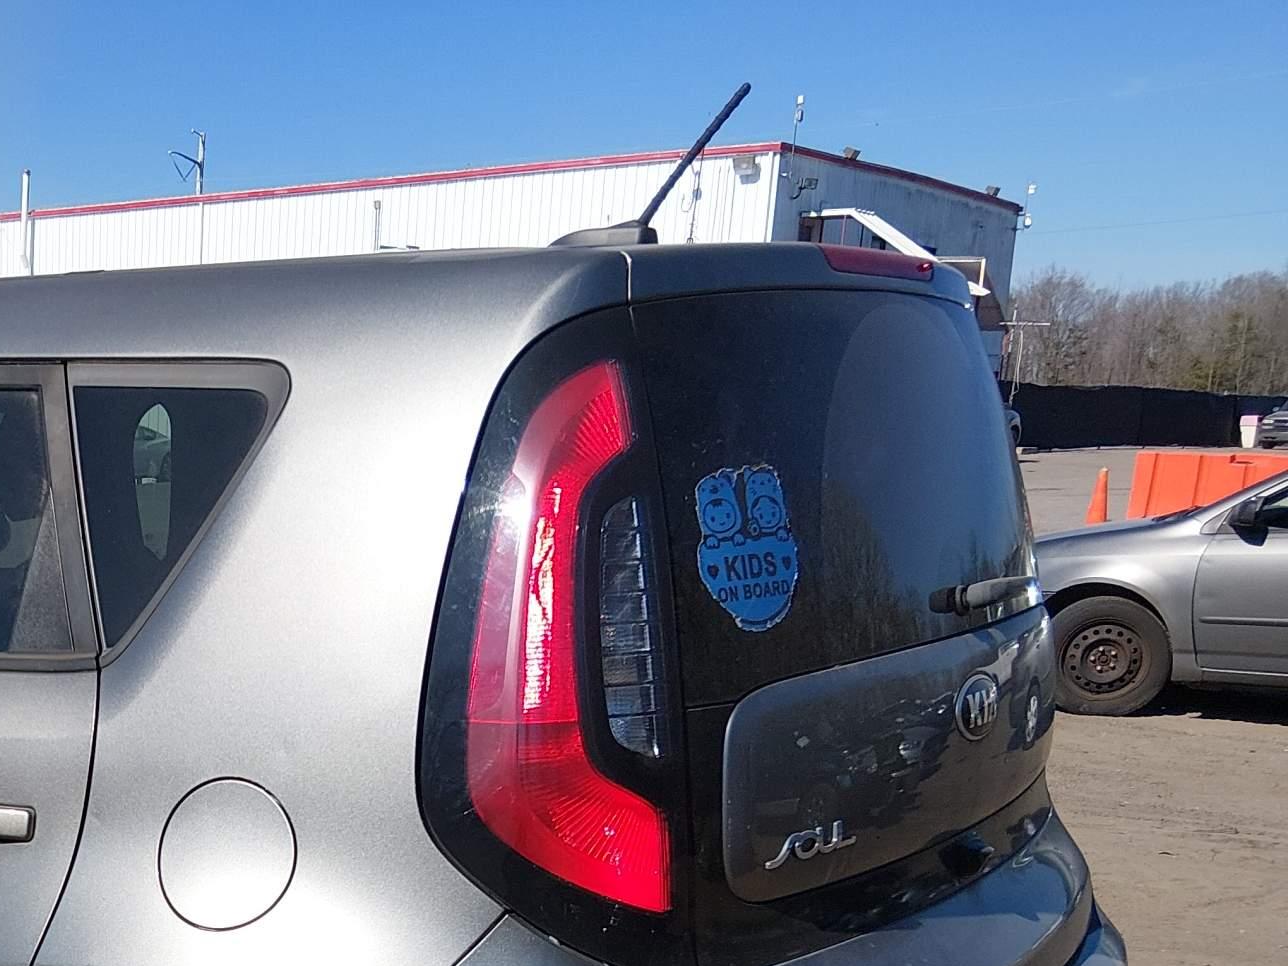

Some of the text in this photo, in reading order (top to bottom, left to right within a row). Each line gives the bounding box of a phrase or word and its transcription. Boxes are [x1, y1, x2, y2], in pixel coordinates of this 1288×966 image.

[724, 551, 777, 582] KIDS
[718, 581, 790, 603] ON BOARD
[965, 683, 998, 729] KIA
